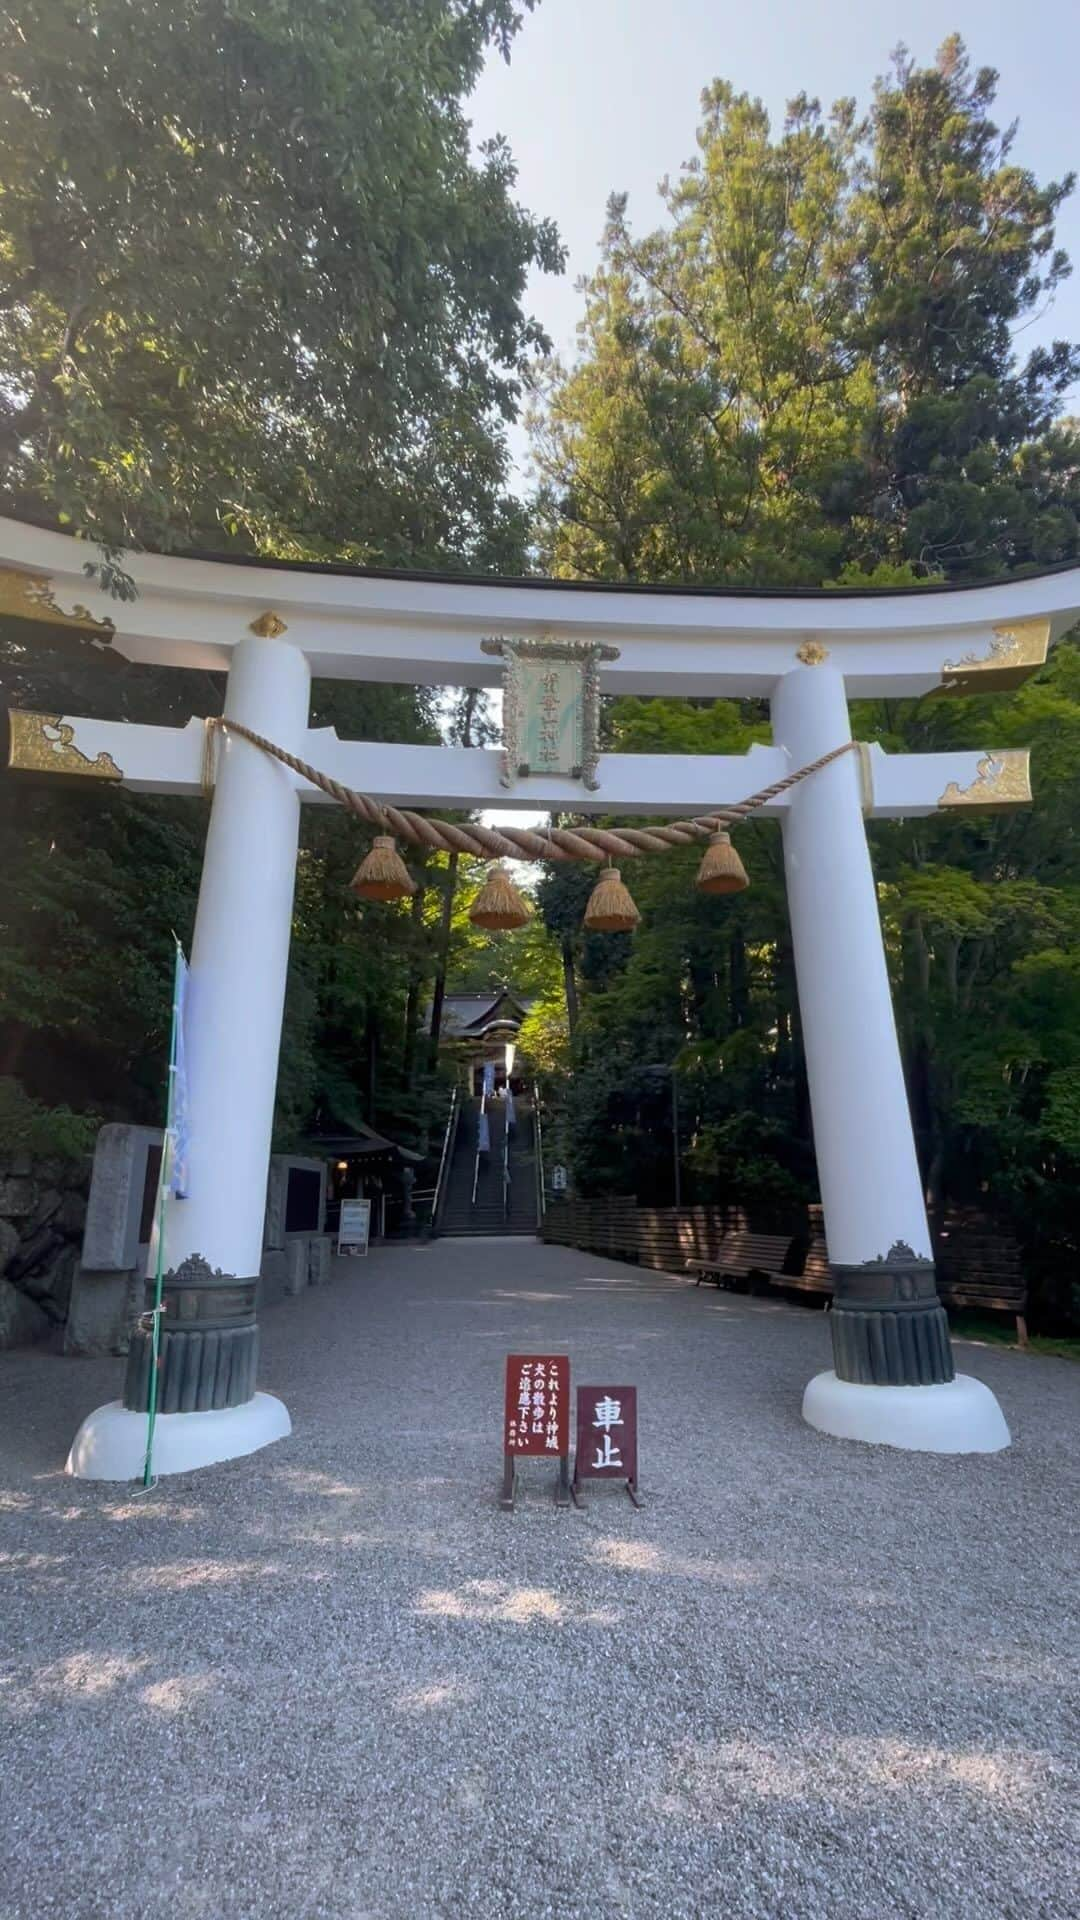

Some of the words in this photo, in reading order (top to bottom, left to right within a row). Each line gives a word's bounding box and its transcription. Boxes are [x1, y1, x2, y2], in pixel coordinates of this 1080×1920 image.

[532, 1362, 546, 1434] 犬の散歩は
[592, 1396, 624, 1469] 車止
